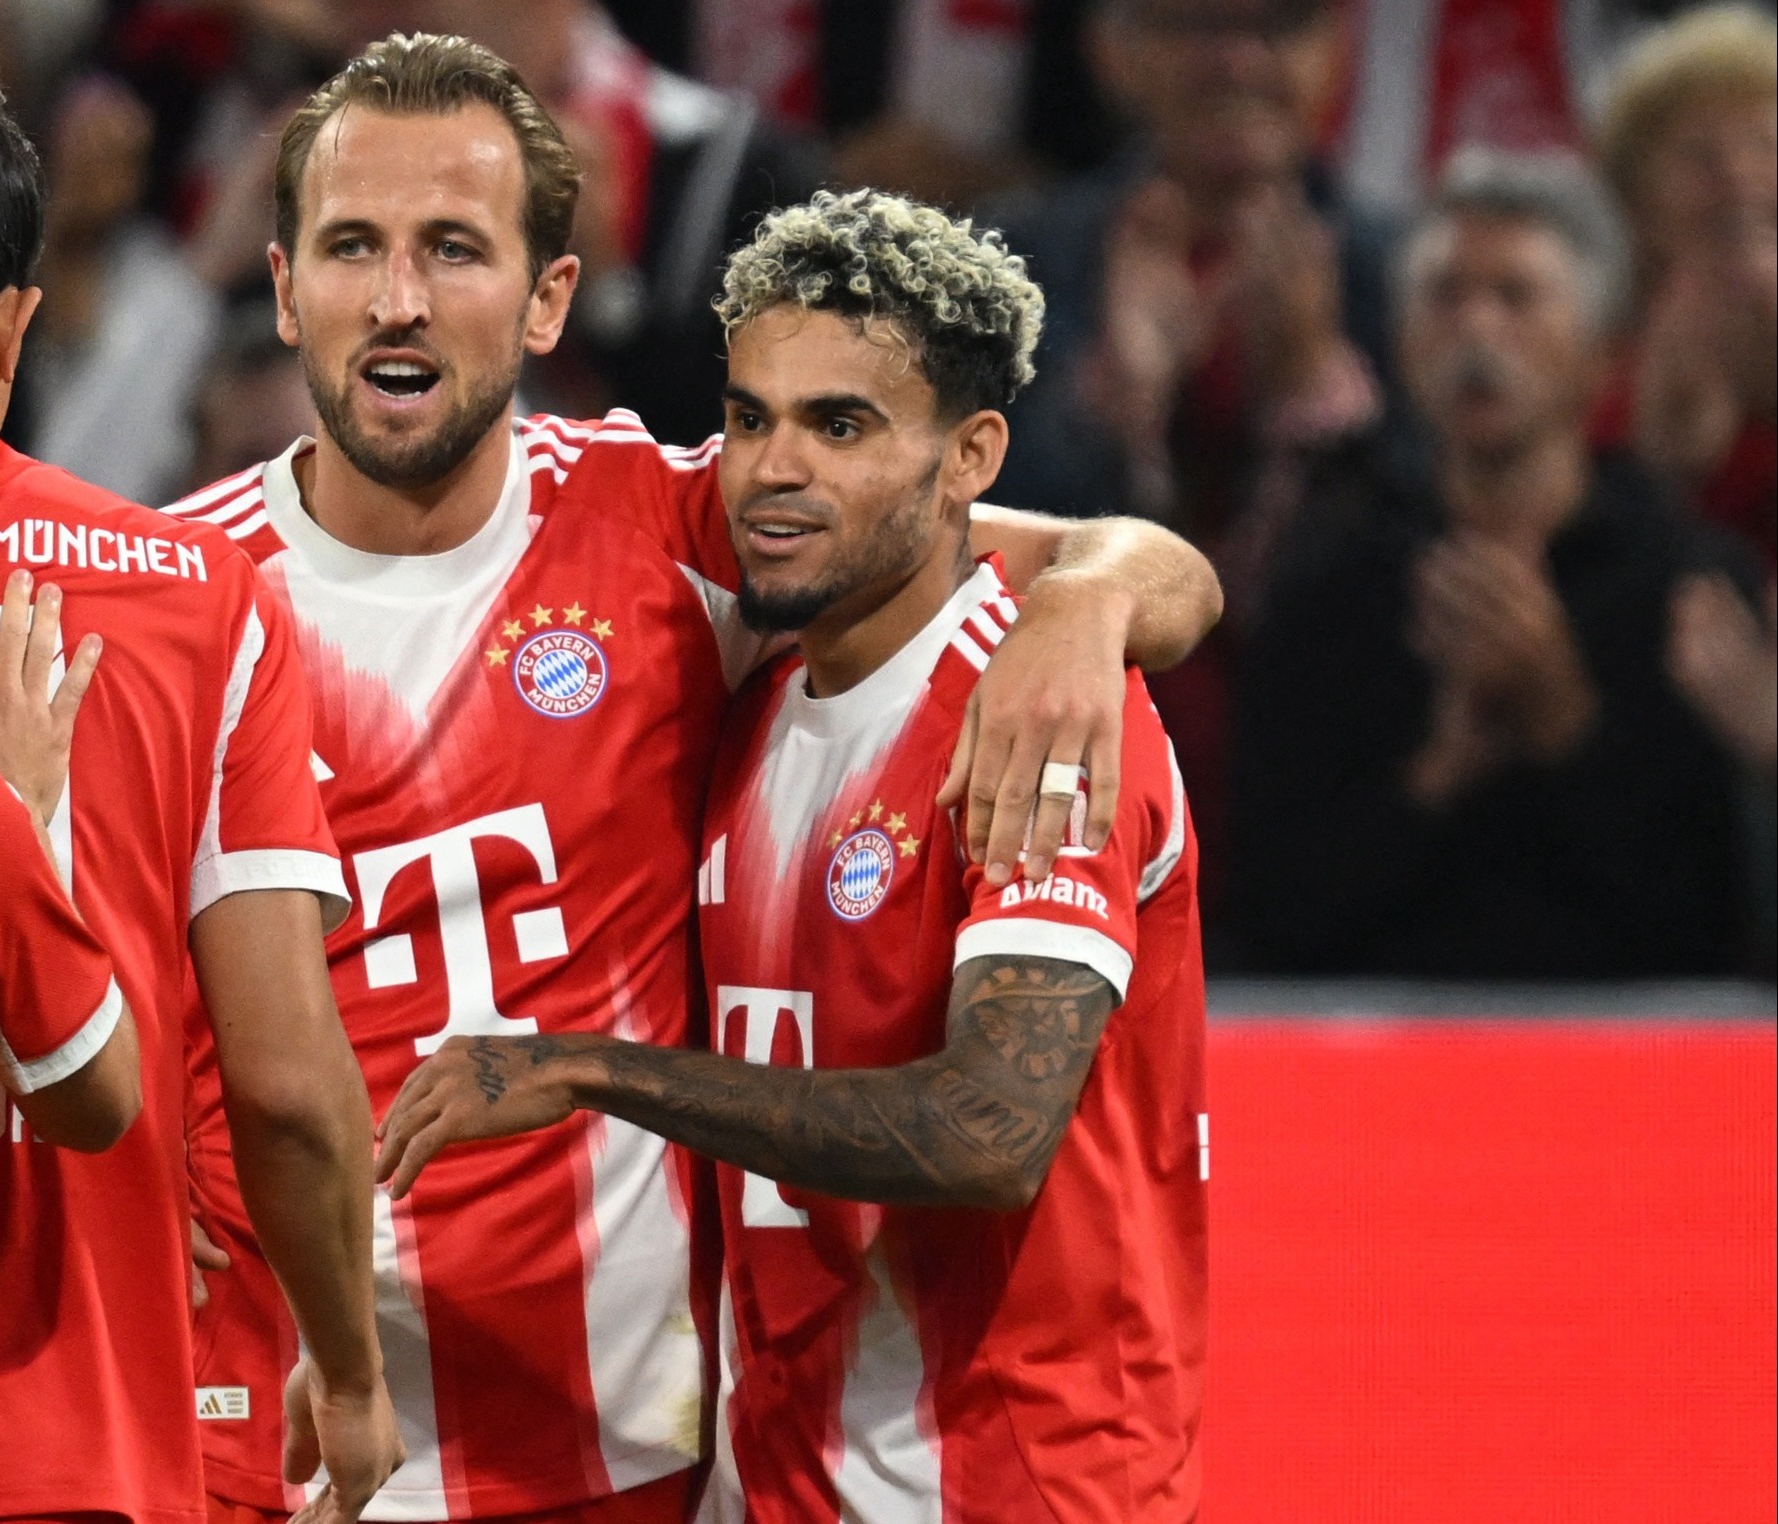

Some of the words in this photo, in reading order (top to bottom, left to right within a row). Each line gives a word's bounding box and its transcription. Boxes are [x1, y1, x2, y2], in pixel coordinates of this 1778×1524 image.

[519, 655, 535, 675] FC
[530, 636, 595, 661] BAYERN
[527, 673, 601, 712] MÜNCHEN
[836, 845, 853, 868] FC
[855, 836, 891, 871] BAYERN
